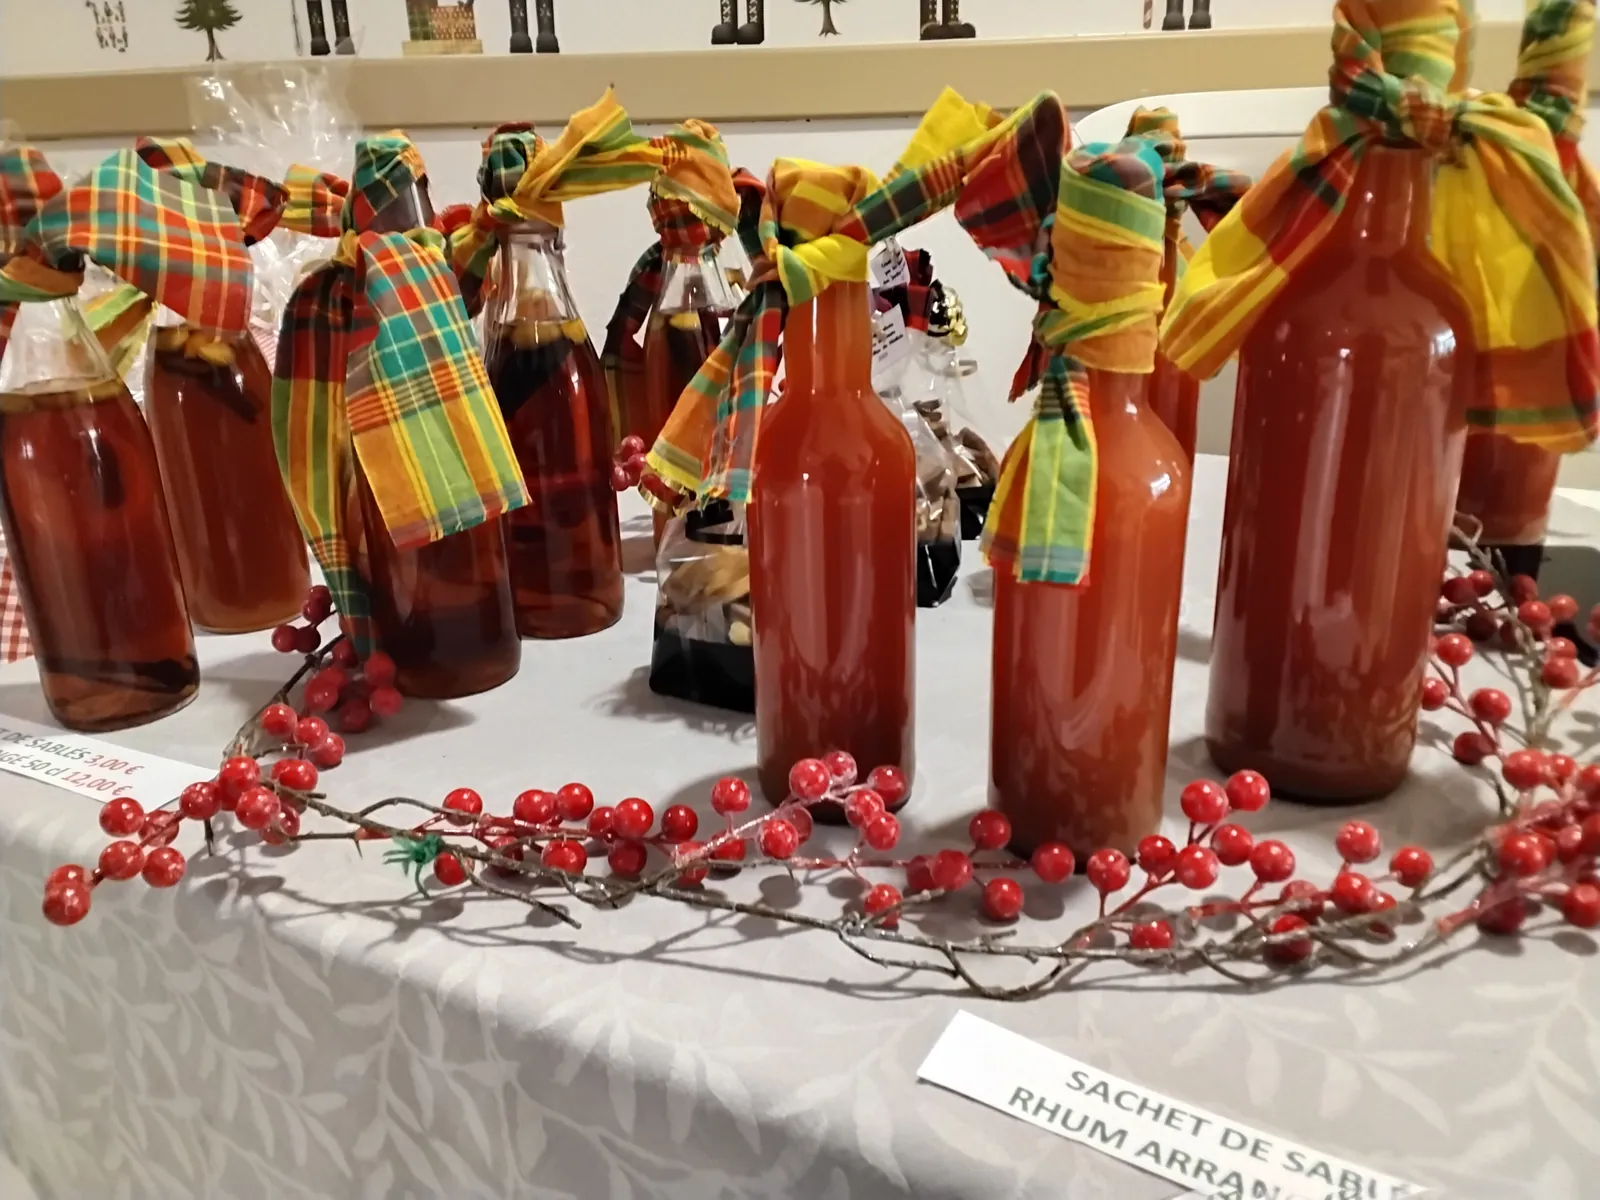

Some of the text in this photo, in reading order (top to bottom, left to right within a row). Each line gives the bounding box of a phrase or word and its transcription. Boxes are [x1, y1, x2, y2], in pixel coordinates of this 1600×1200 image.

[2, 732, 35, 745] DE
[24, 738, 92, 760] SABLÉS
[83, 754, 130, 771] 3,00
[124, 765, 146, 775] €
[20, 759, 52, 771] 50
[44, 767, 72, 776] cl
[60, 771, 117, 791] 12,00
[111, 785, 134, 796] €
[1007, 1086, 1303, 1200] RHUM ARRAN
[1065, 1070, 1213, 1138] SACHET
[1219, 1127, 1273, 1163] DE
